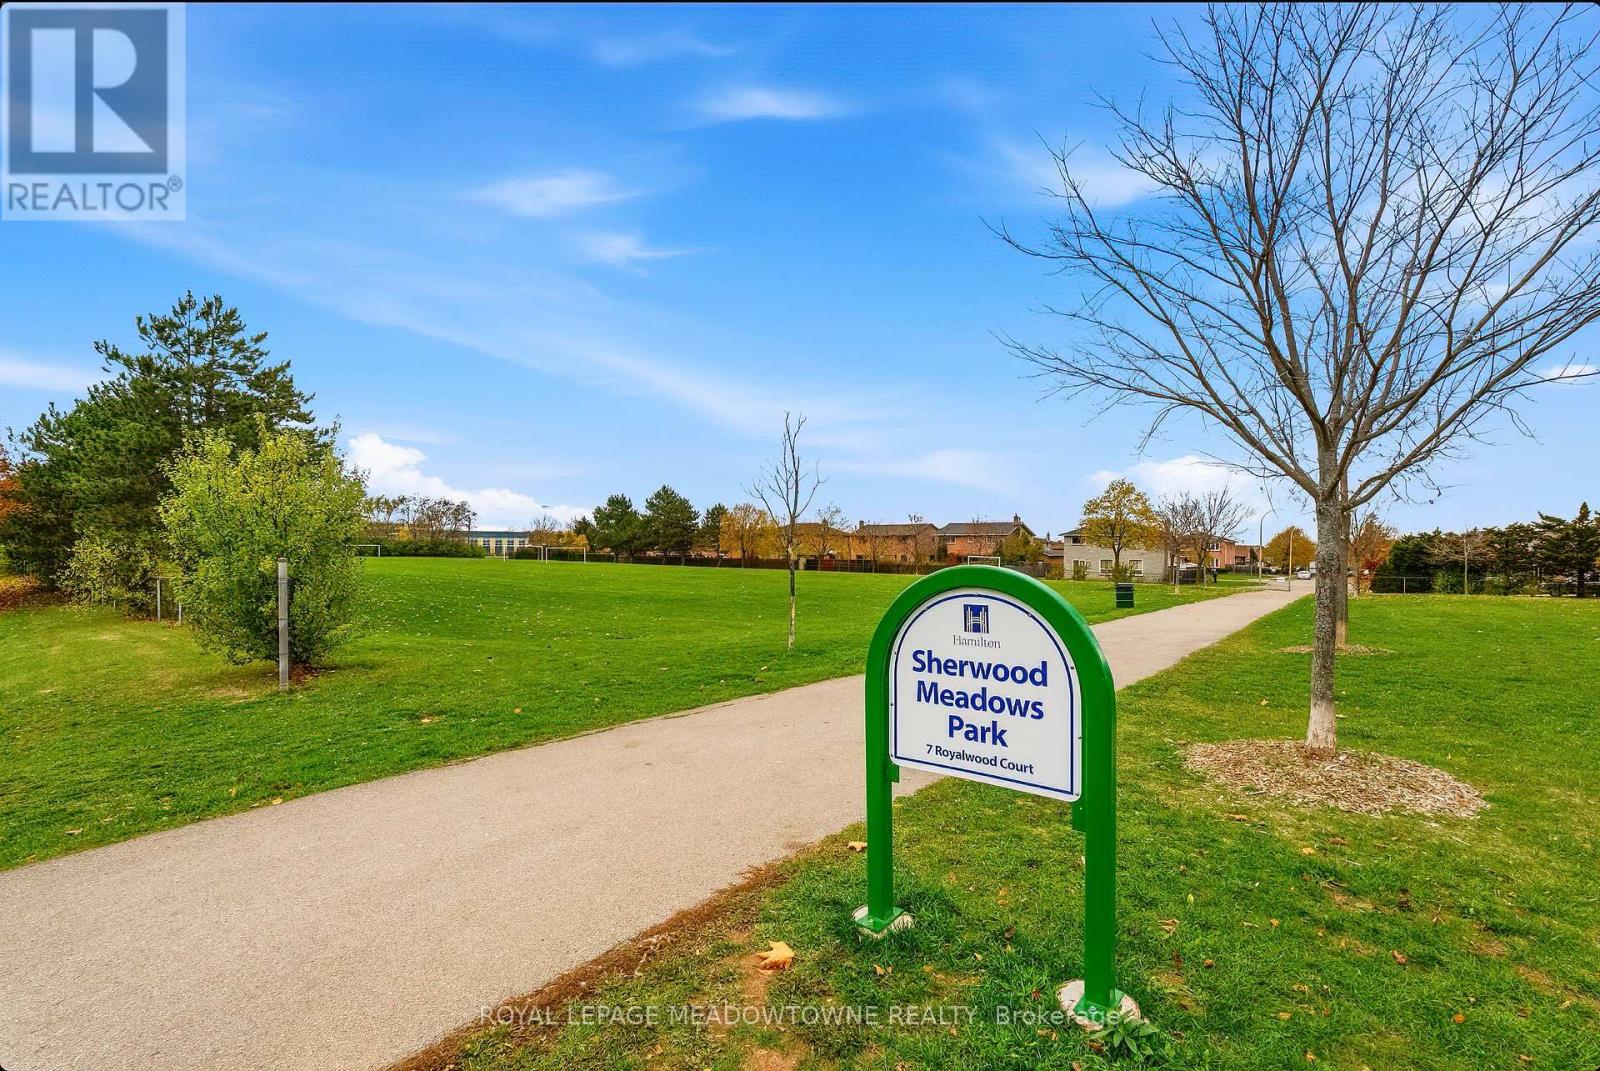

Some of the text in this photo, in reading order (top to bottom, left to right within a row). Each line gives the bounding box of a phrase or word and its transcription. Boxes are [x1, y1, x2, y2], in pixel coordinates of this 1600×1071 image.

[953, 635, 1001, 649] Hamilton
[912, 649, 1048, 687] Sherwood
[916, 680, 1044, 720] Meadows
[948, 715, 1008, 748] Park
[926, 744, 1034, 774] 7 Royalwood Court
